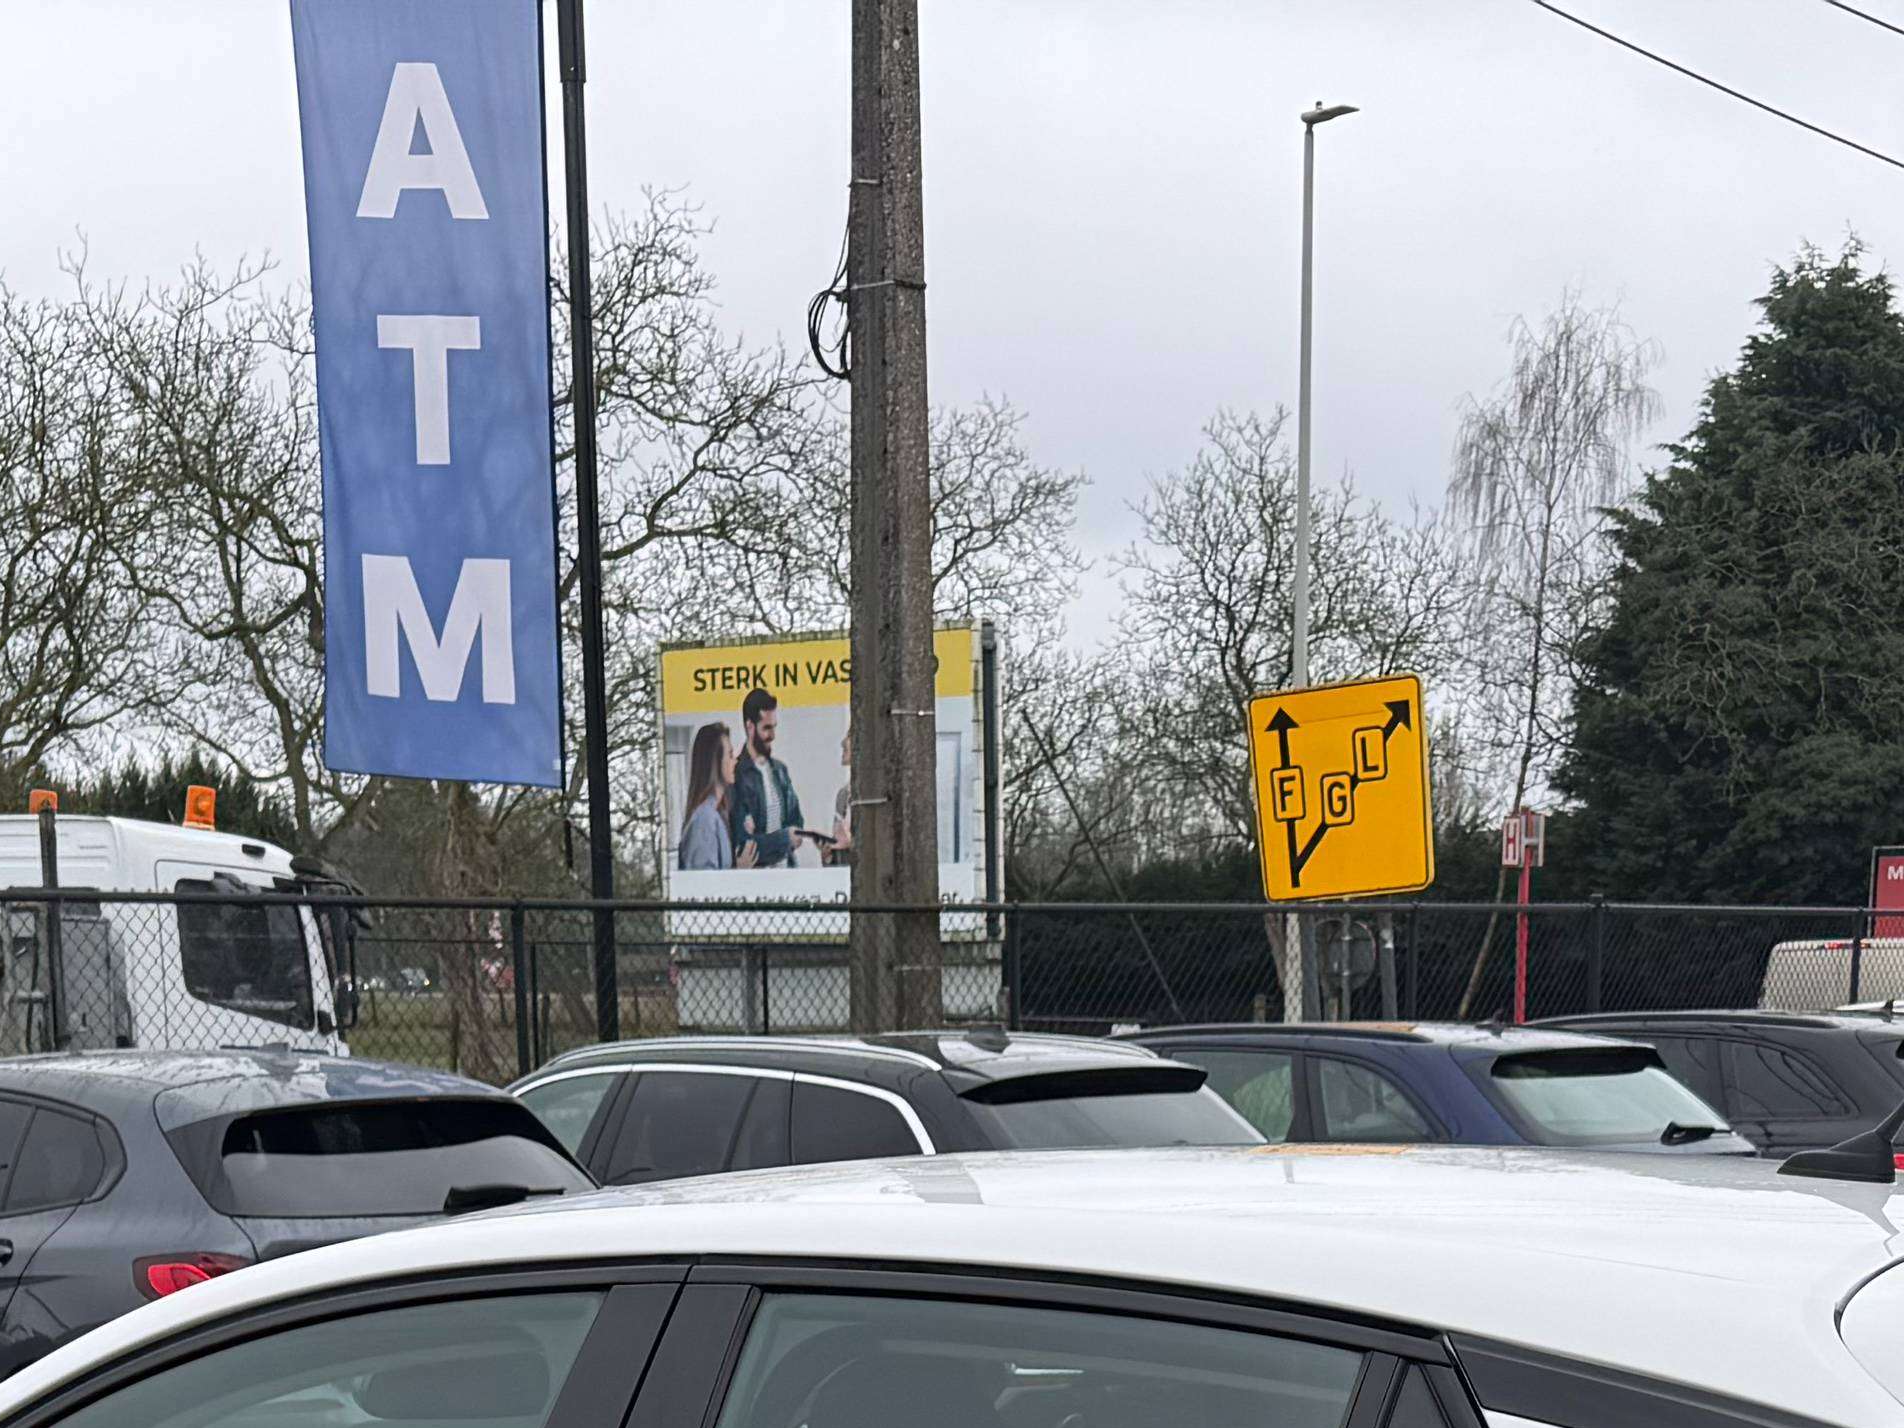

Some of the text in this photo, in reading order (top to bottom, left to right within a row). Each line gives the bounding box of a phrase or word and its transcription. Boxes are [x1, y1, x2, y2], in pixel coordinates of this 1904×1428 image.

[356, 62, 516, 705] ATM
[693, 664, 767, 692] STERK
[775, 662, 798, 687] IN
[1360, 736, 1379, 772] L
[1279, 776, 1296, 812] F
[1327, 781, 1347, 818] G
